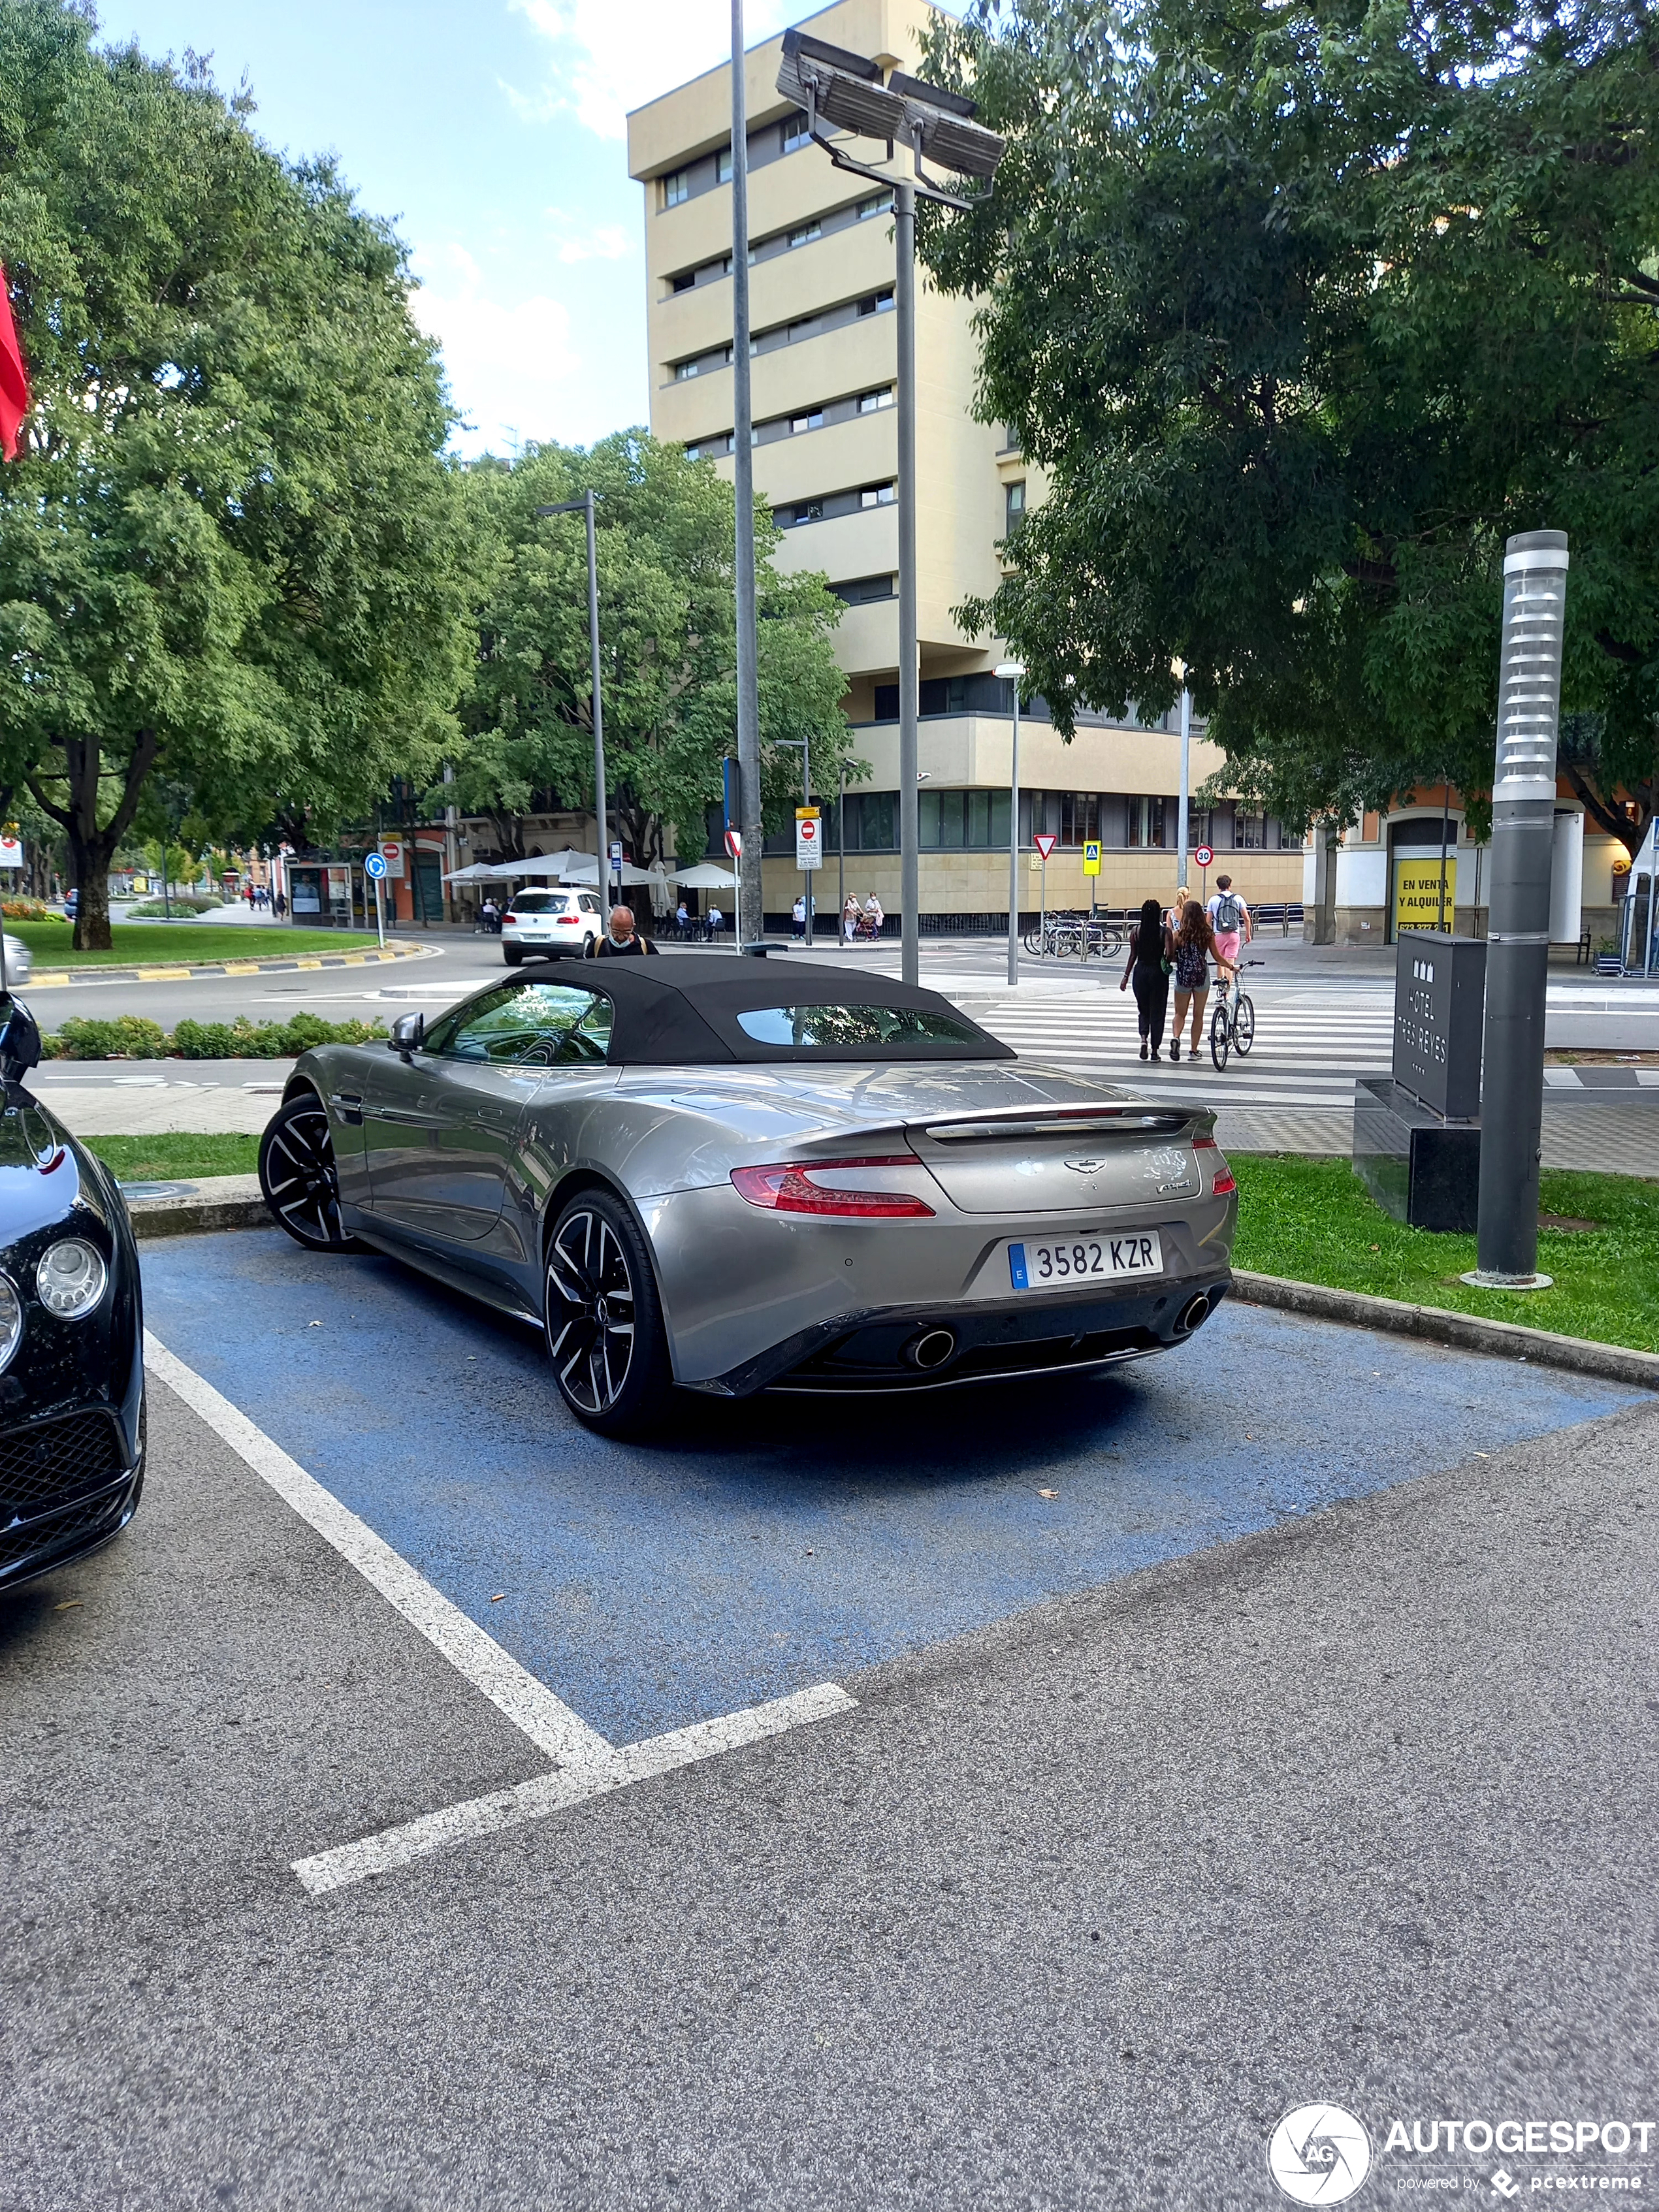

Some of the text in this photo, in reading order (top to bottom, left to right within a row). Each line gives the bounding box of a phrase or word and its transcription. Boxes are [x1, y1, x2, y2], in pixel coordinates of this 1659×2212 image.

[1403, 880, 1449, 890] EN VENTA
[1399, 897, 1452, 908] Y ALQUILER
[1409, 988, 1434, 1020] HOTEL
[1398, 1016, 1446, 1064] TRES REYES
[1037, 1238, 1154, 1278] 3582 KZR
[1016, 1270, 1023, 1279] E
